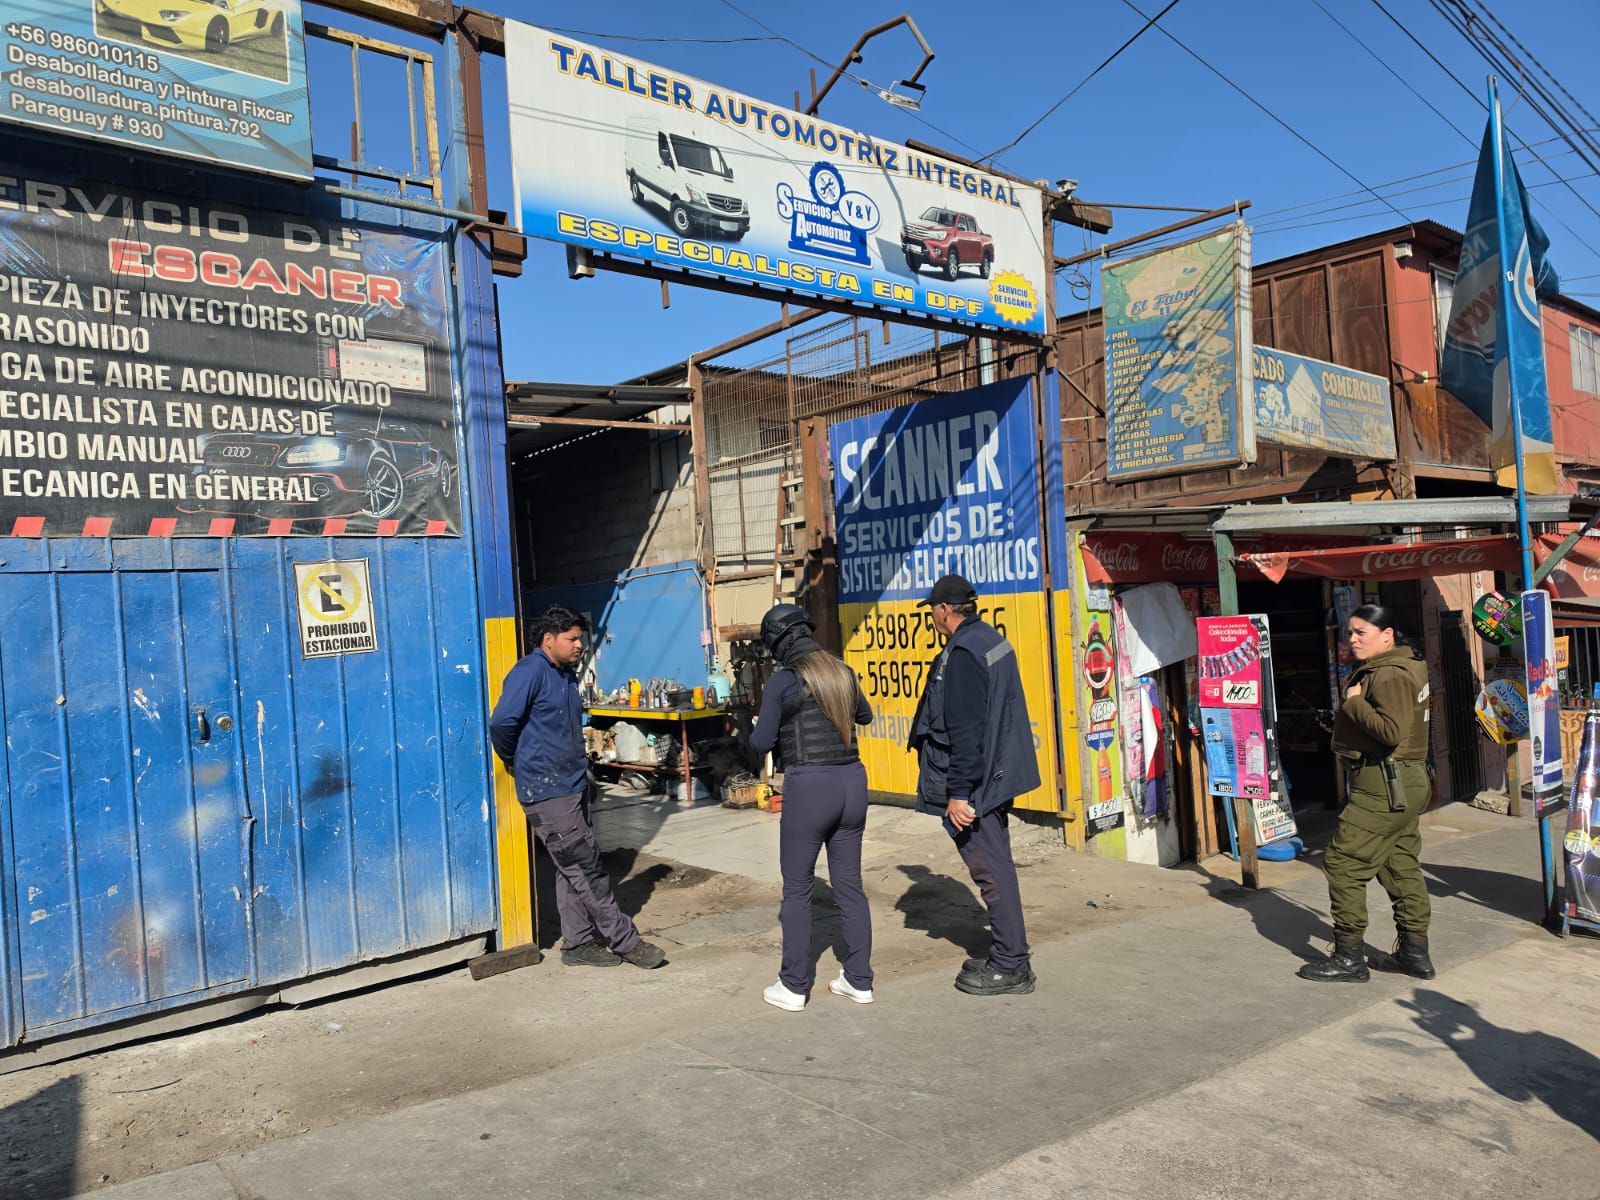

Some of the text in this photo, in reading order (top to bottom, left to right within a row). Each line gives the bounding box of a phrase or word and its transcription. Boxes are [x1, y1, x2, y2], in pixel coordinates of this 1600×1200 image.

[7, 24, 158, 72] +56 986010115
[8, 45, 293, 125] Desabolladura y Pintura Fixcar
[9, 70, 261, 139] desabolladura.pintura.792
[11, 92, 164, 140] Paraguay # 930
[549, 39, 1021, 209] TALLER AUTOMOTRIZ INTEGRAL
[777, 182, 832, 220] SERVICIOS
[283, 221, 361, 261] DE
[795, 213, 852, 243] AUTOMOTRIZ
[108, 237, 406, 310] ESCANER
[557, 210, 984, 317] ESPECIALISTA EN DPF
[994, 294, 1033, 310] DE ESCANER
[998, 284, 1029, 298] SERVICIO
[1130, 298, 1148, 316] El
[93, 285, 132, 316] DE
[140, 291, 309, 334] INYECTORES
[315, 312, 366, 341] CON
[1112, 330, 1128, 340] PAN
[1112, 337, 1137, 350] POLLO
[1112, 347, 1140, 359] CARNE
[1113, 351, 1162, 368] EMBUTIDOS
[2, 351, 392, 407] GA DE AIRE ACONDICIONADO
[1114, 373, 1145, 387] FRUTAS
[1321, 370, 1385, 406] COMERCIAL
[0, 389, 337, 436] ECIALISTA EN CAJAS DE
[77, 433, 205, 464] MANUAL
[1134, 440, 1145, 449] DE
[1146, 433, 1185, 446] LIBRERIA
[1134, 449, 1145, 458] DE
[1146, 445, 1168, 456] ASEO
[840, 410, 1004, 515] SCANNER
[1122, 457, 1153, 469] MUCHO
[2, 468, 319, 502] ECANICA EN GENERAL
[844, 507, 962, 554] SERVICIOS
[840, 536, 1039, 594] SISTEMAS ELECTRONICOS
[305, 635, 373, 654] ESTACIONAR
[307, 621, 367, 639] PROHIBIDO
